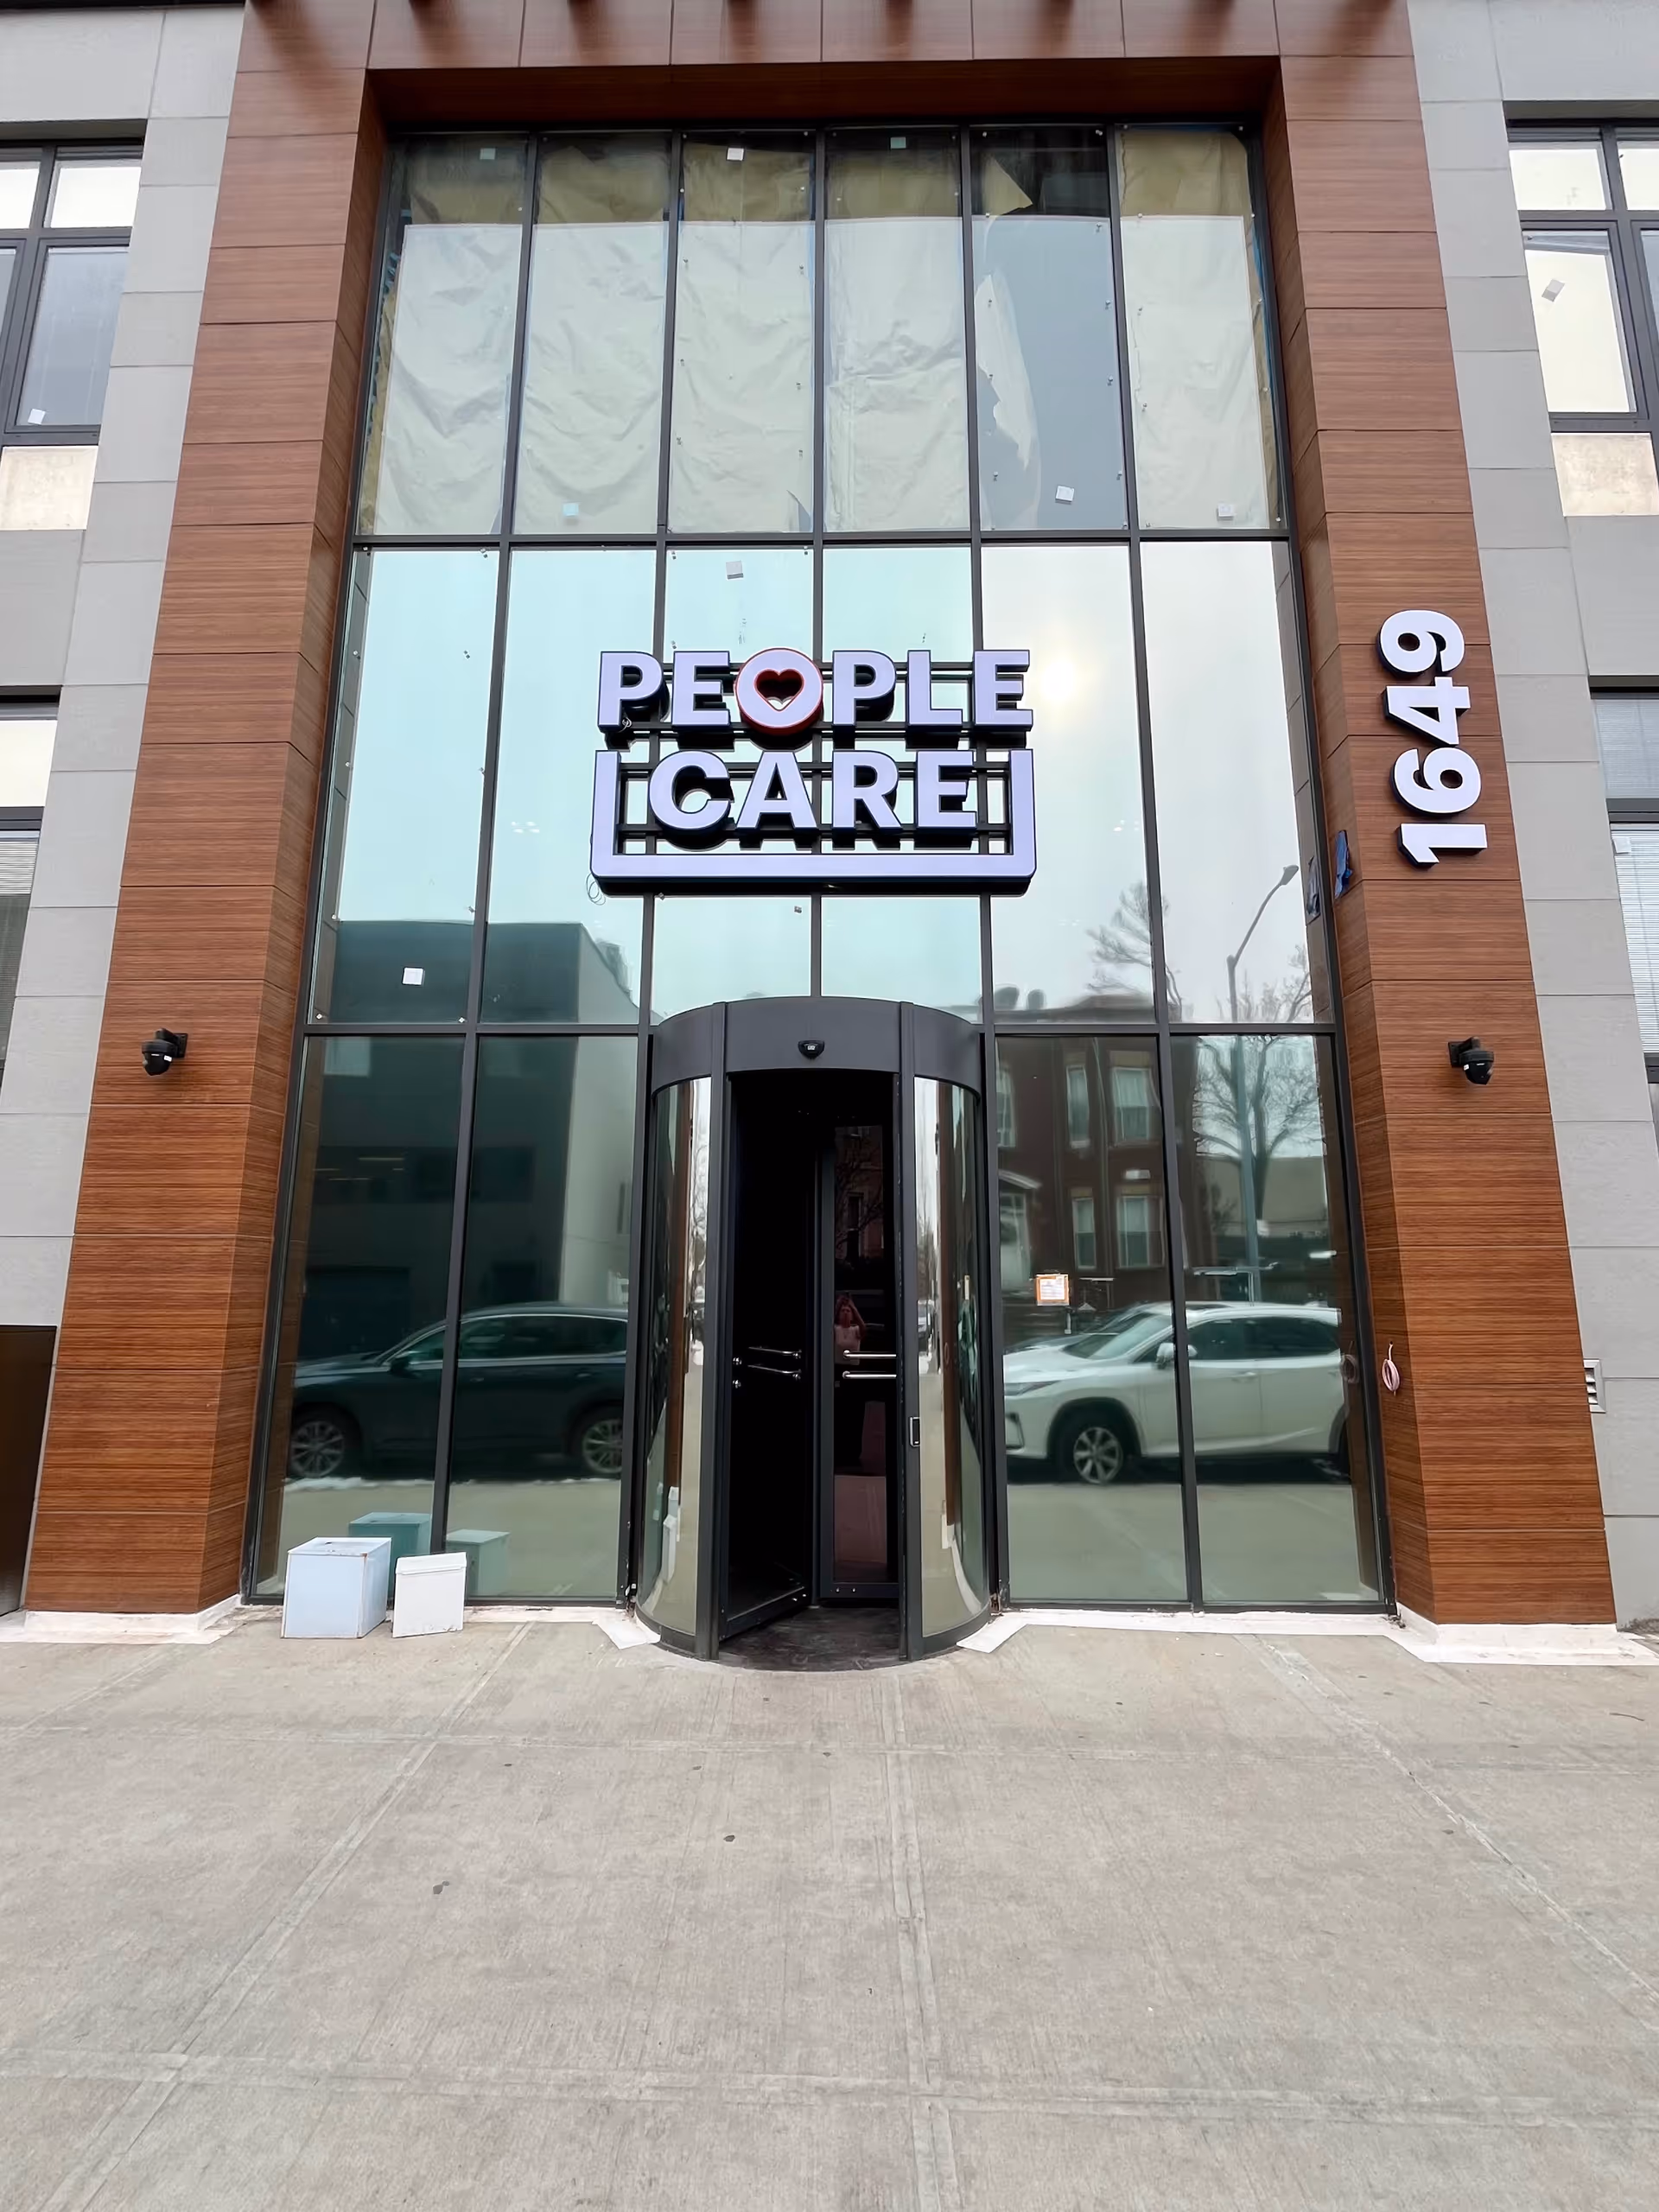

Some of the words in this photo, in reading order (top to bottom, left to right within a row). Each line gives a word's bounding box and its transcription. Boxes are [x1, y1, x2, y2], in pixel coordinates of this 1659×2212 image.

[597, 648, 1033, 731] PEOPLE
[1377, 609, 1488, 866] 1649
[647, 750, 978, 832] CARE
